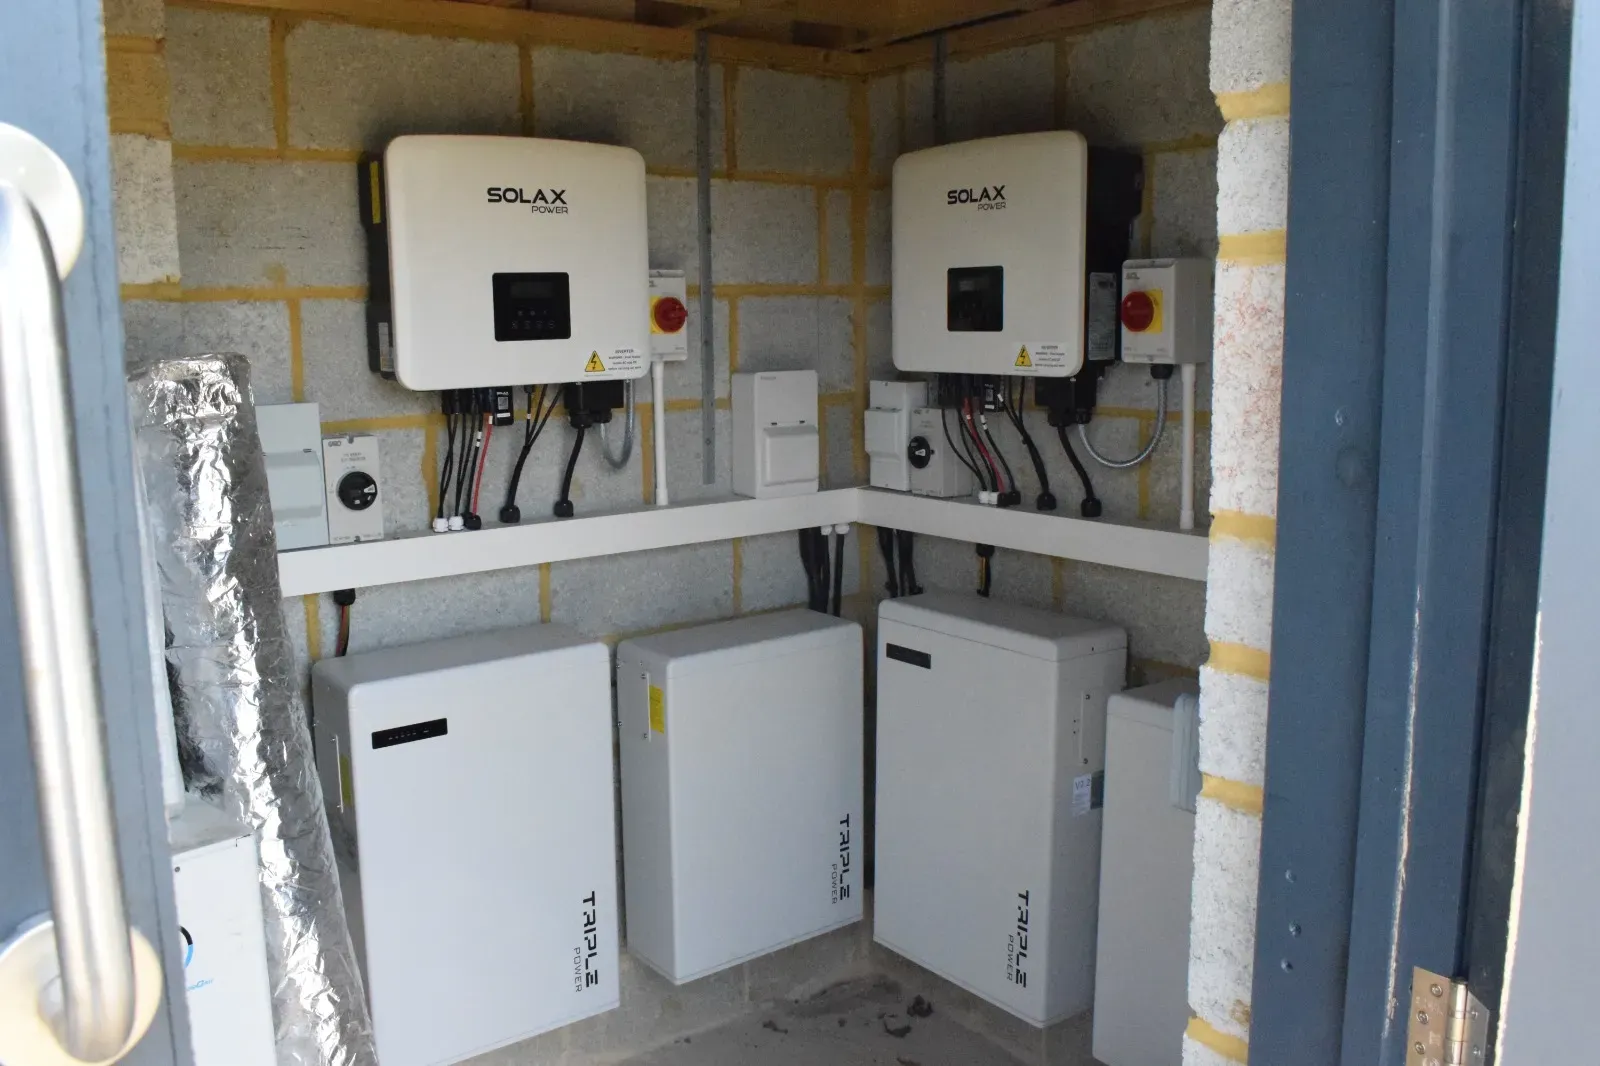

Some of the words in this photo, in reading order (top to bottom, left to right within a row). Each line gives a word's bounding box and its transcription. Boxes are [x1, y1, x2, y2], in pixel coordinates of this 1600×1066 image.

[487, 187, 567, 205] SOLAX
[531, 205, 569, 214] POWER
[947, 185, 1006, 205] SOLAX
[977, 201, 1007, 212] POWER
[840, 813, 850, 901] TRIPLE
[583, 890, 599, 988] TRIPLE
[1006, 934, 1015, 981] POWER
[1015, 889, 1029, 989] TRIPLE
[573, 946, 582, 993] POWER
